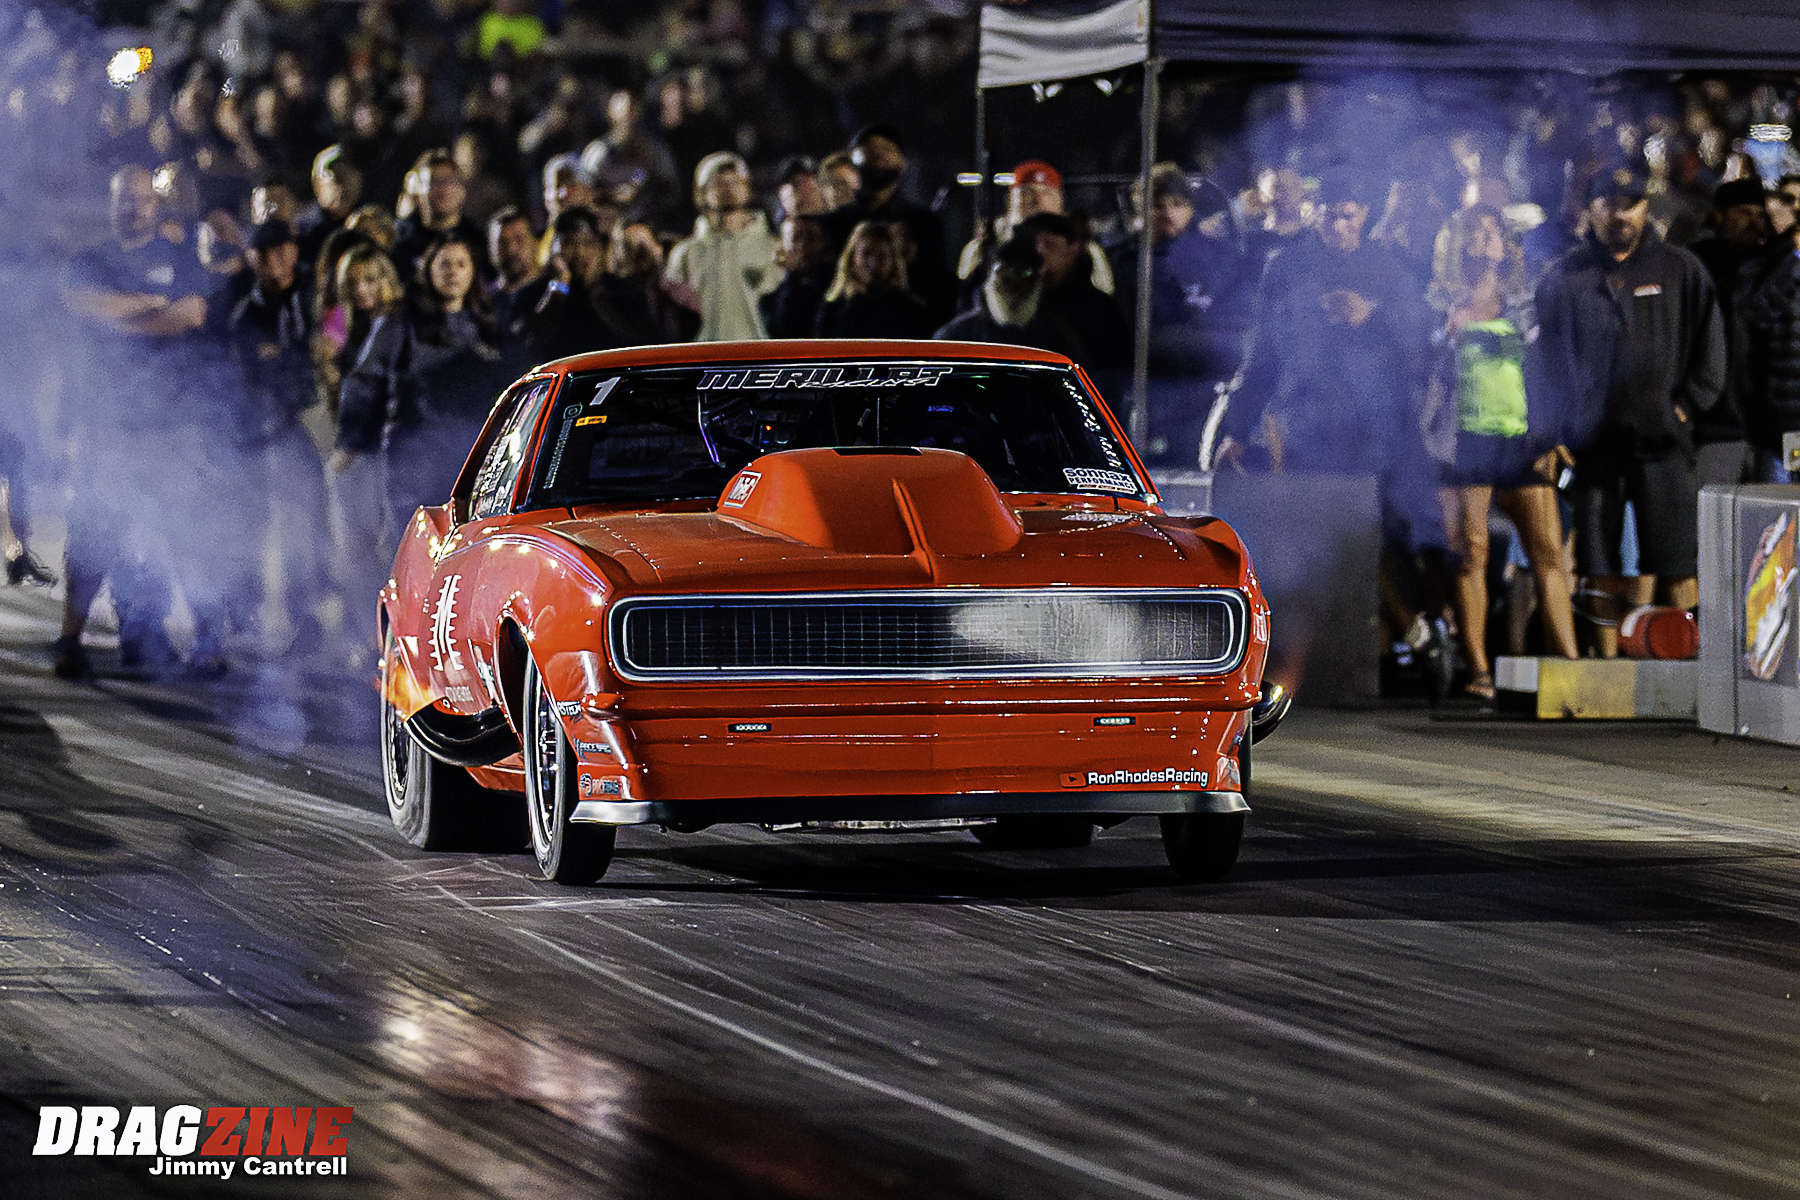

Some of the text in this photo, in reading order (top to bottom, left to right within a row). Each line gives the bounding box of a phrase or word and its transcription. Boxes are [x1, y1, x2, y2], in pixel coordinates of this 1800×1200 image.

[697, 366, 954, 390] MERILLAT
[589, 376, 622, 406] 1
[1064, 469, 1132, 482] sonnax
[1068, 477, 1137, 490] PERFORMANCE
[1088, 767, 1209, 788] RonRhodesRacing
